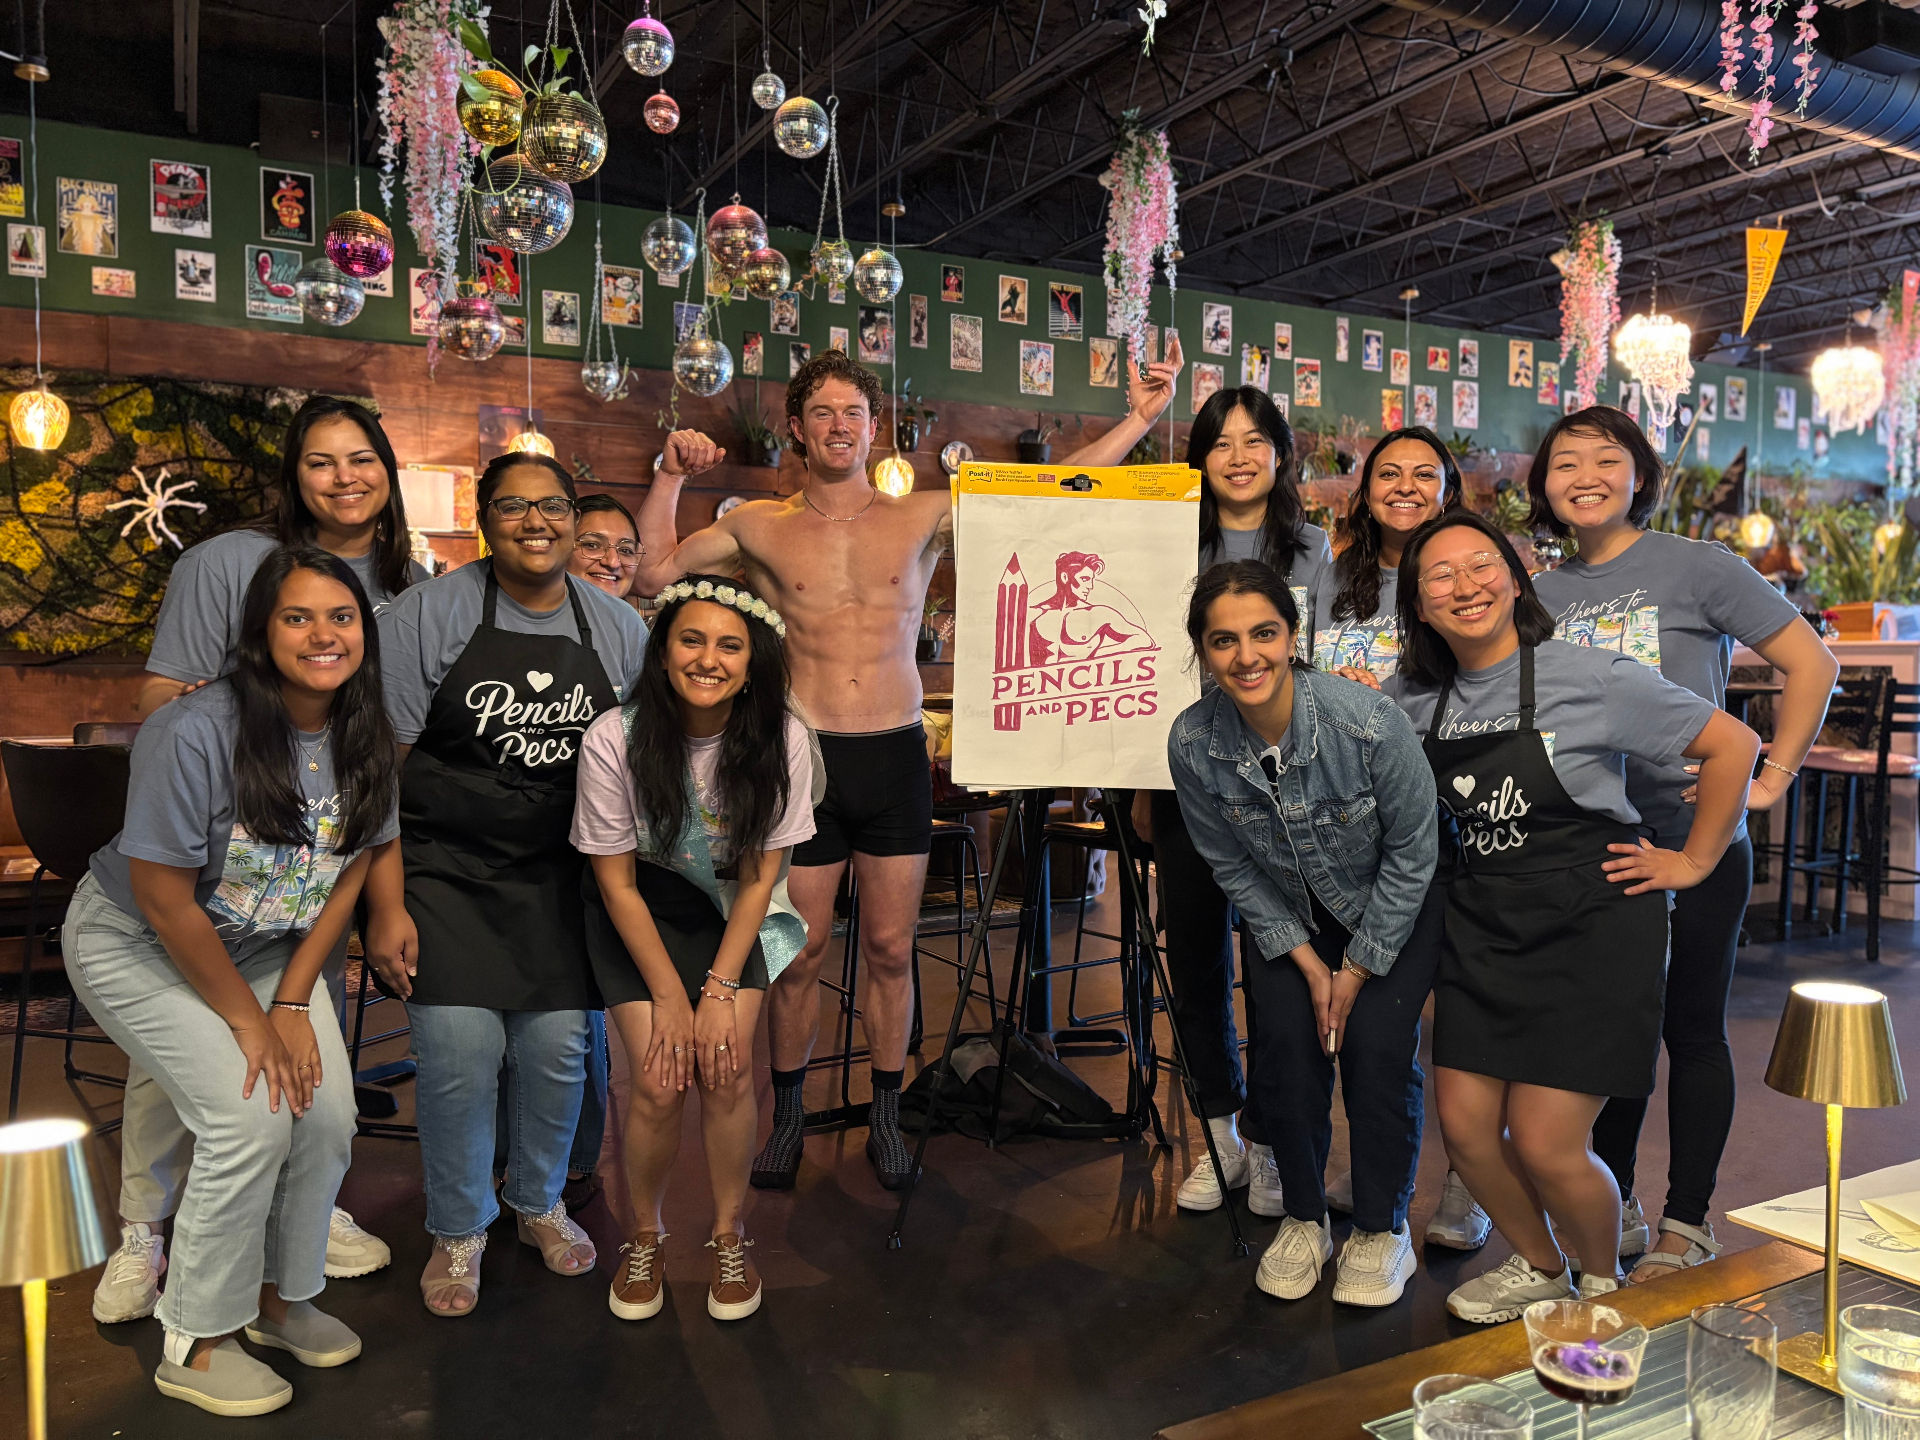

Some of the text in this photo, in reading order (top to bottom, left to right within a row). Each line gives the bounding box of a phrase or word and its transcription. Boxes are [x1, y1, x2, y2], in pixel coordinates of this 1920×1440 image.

[968, 470, 991, 478] Post-it
[1556, 598, 1622, 624] Cheers
[992, 656, 1156, 700] PENCILS
[465, 680, 598, 737] Pencils
[1026, 691, 1158, 725] AND PECS
[518, 726, 546, 735] AND
[492, 731, 576, 768] Pecs
